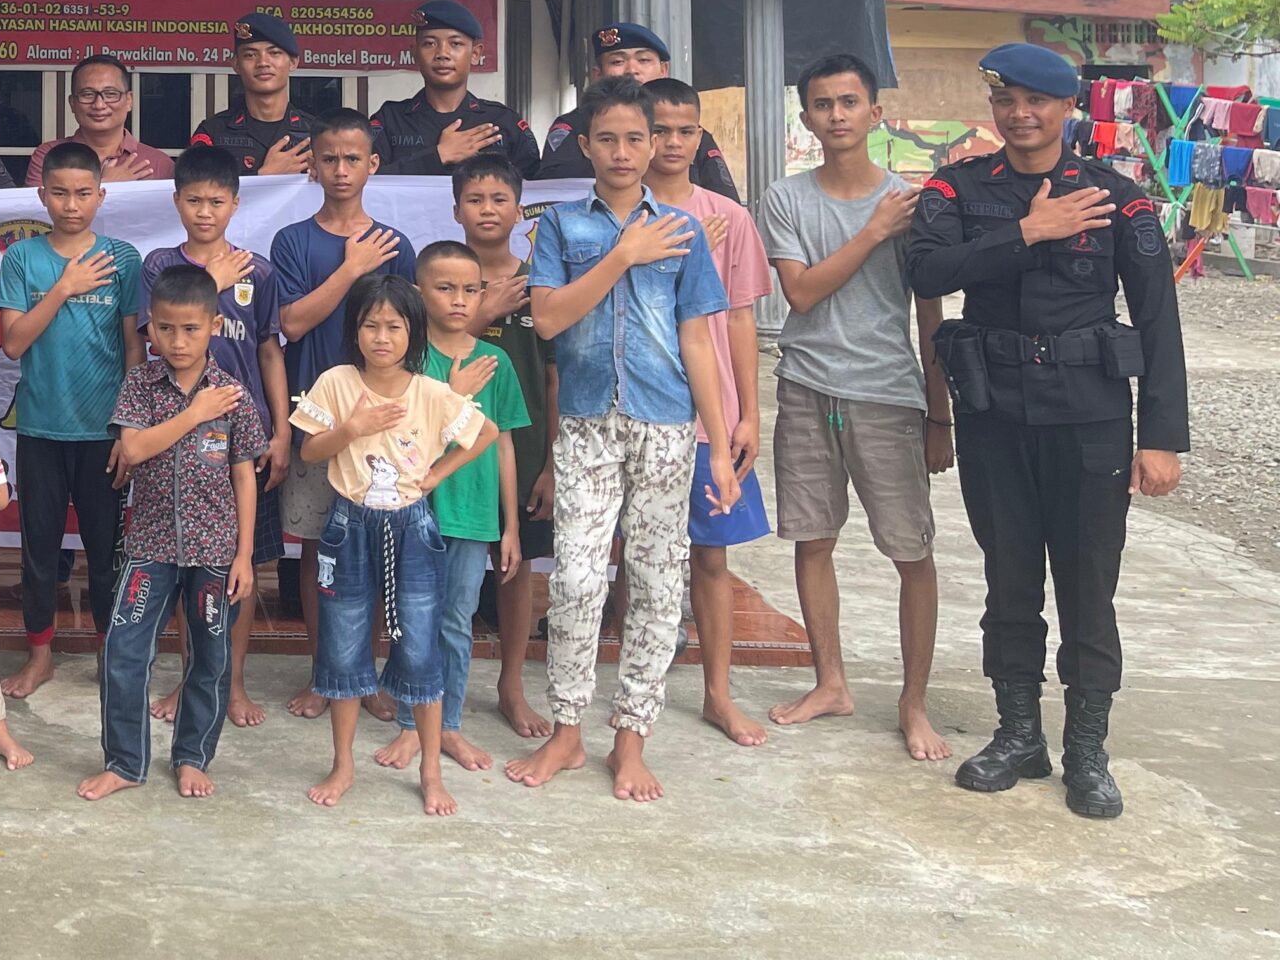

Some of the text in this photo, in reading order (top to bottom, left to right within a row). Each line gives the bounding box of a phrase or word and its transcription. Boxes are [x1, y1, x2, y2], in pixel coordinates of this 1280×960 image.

[291, 7, 374, 19] 8205454566
[49, 20, 102, 32] HASAMI
[106, 21, 148, 33] KASIH
[152, 21, 229, 33] INDONESIA
[288, 23, 387, 36] AKHOSITODO
[27, 45, 72, 59] Alamat
[177, 48, 199, 62] No.
[203, 49, 219, 61] 24
[304, 50, 357, 66] Bengkel
[360, 51, 395, 67] Baru,
[391, 135, 425, 147] BIMA
